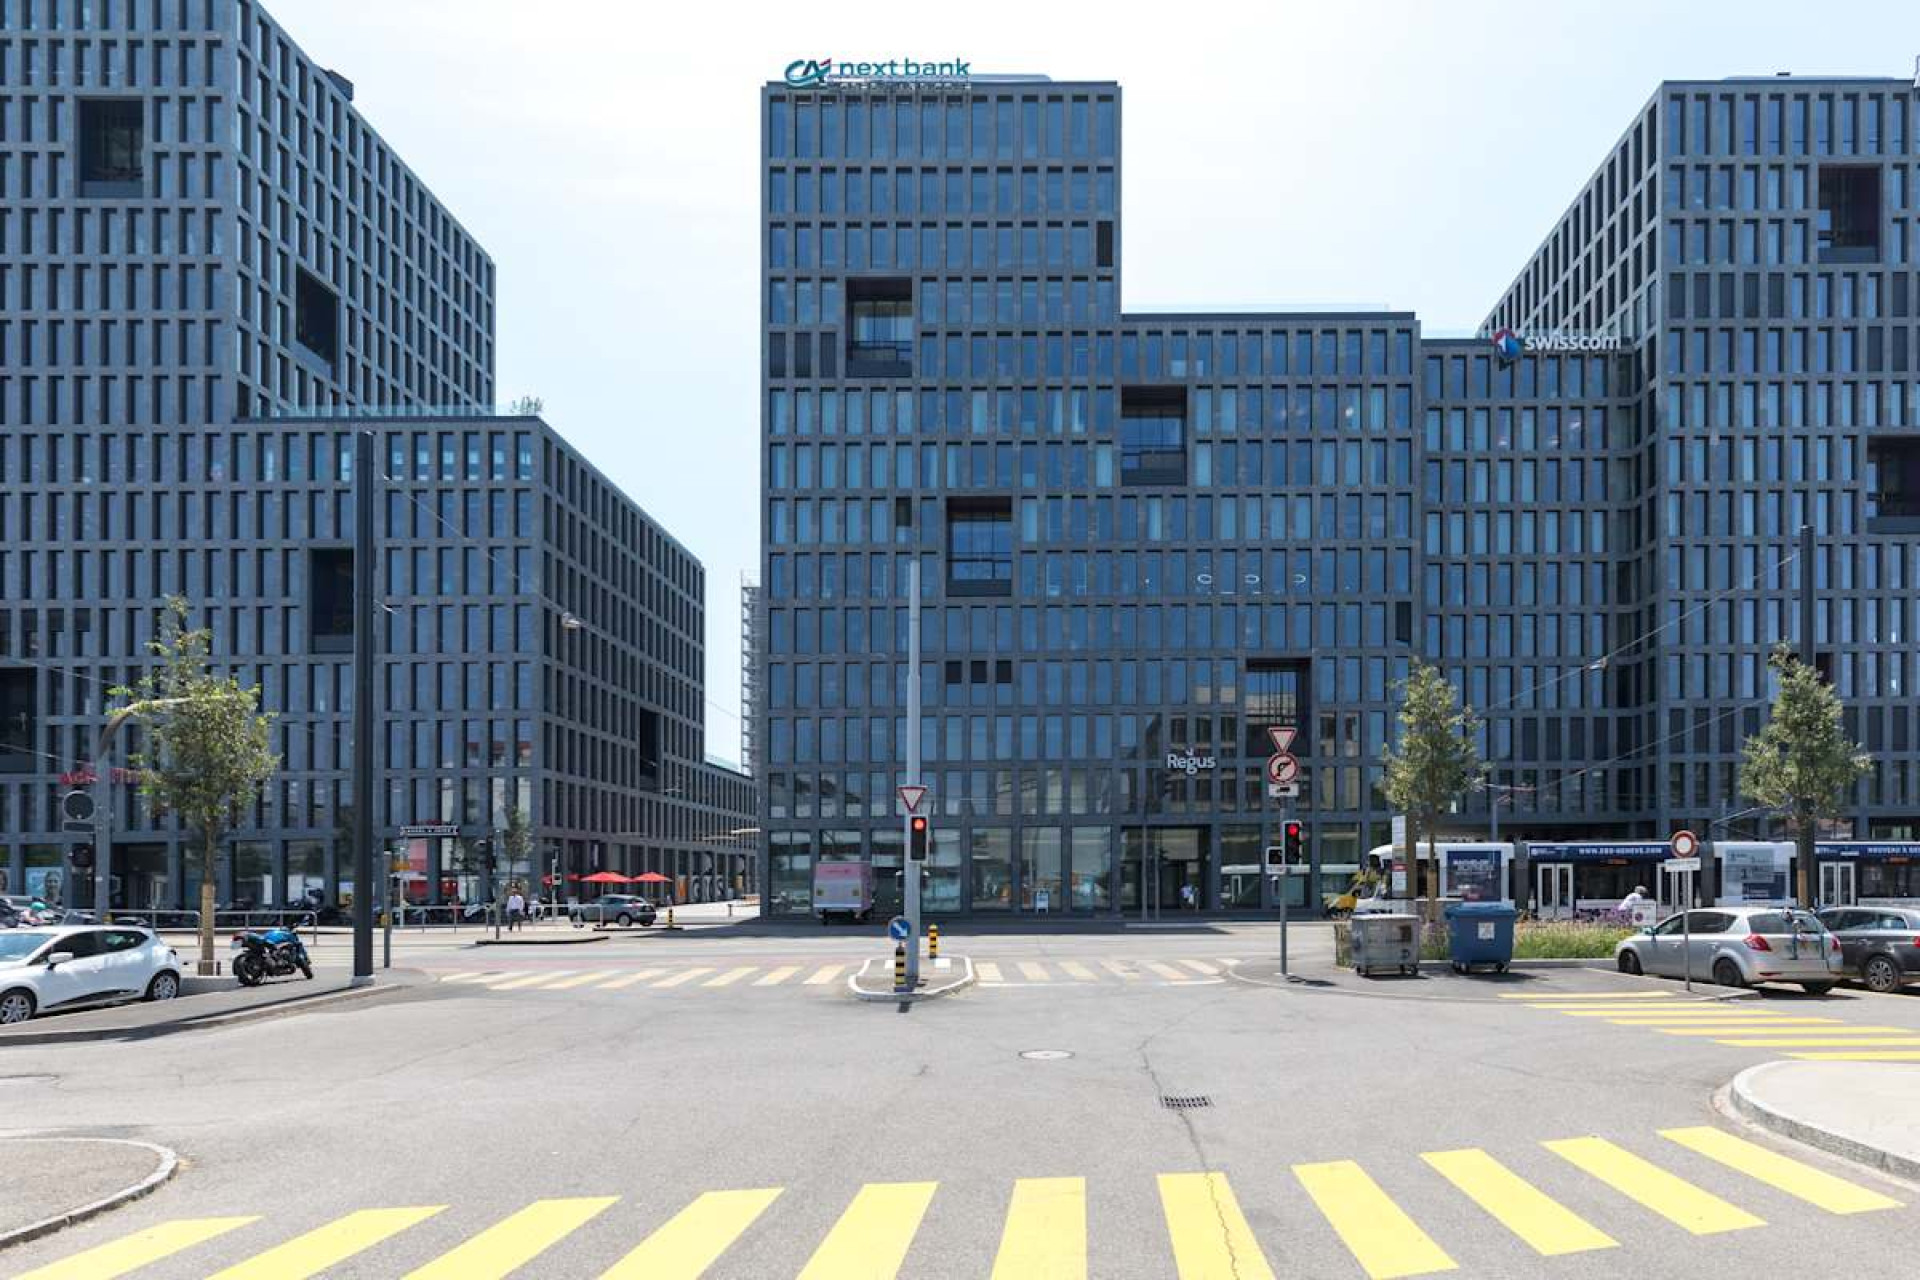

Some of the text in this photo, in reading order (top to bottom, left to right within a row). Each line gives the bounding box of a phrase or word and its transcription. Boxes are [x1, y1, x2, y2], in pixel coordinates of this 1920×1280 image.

[840, 59, 900, 76] next
[905, 57, 970, 76] bank
[1524, 330, 1621, 350] swisscom
[1167, 752, 1217, 775] Regus
